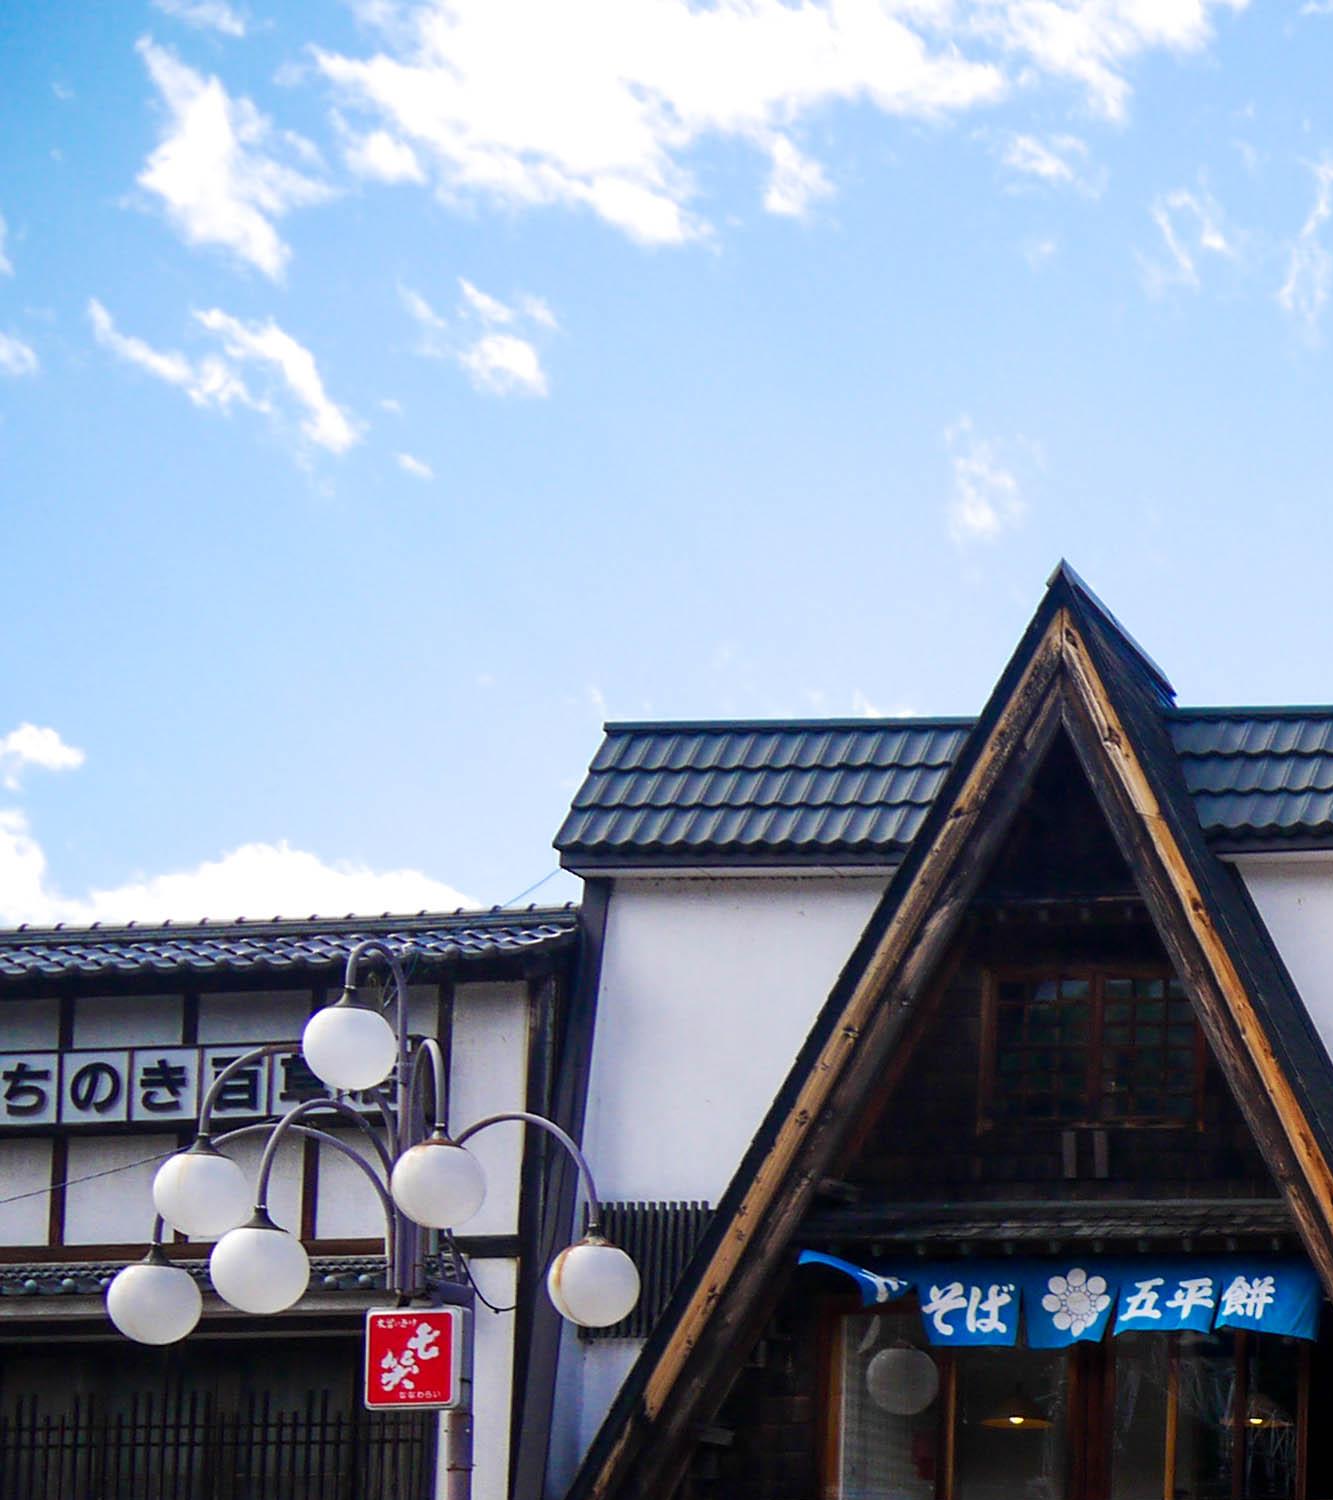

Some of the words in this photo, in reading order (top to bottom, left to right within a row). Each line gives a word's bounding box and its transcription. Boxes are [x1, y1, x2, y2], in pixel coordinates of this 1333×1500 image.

[921, 1282, 1015, 1336] そば
[1120, 1276, 1276, 1321] 五平餅
[380, 1322, 441, 1392] 七笑
[399, 1390, 441, 1399] ななわらい
